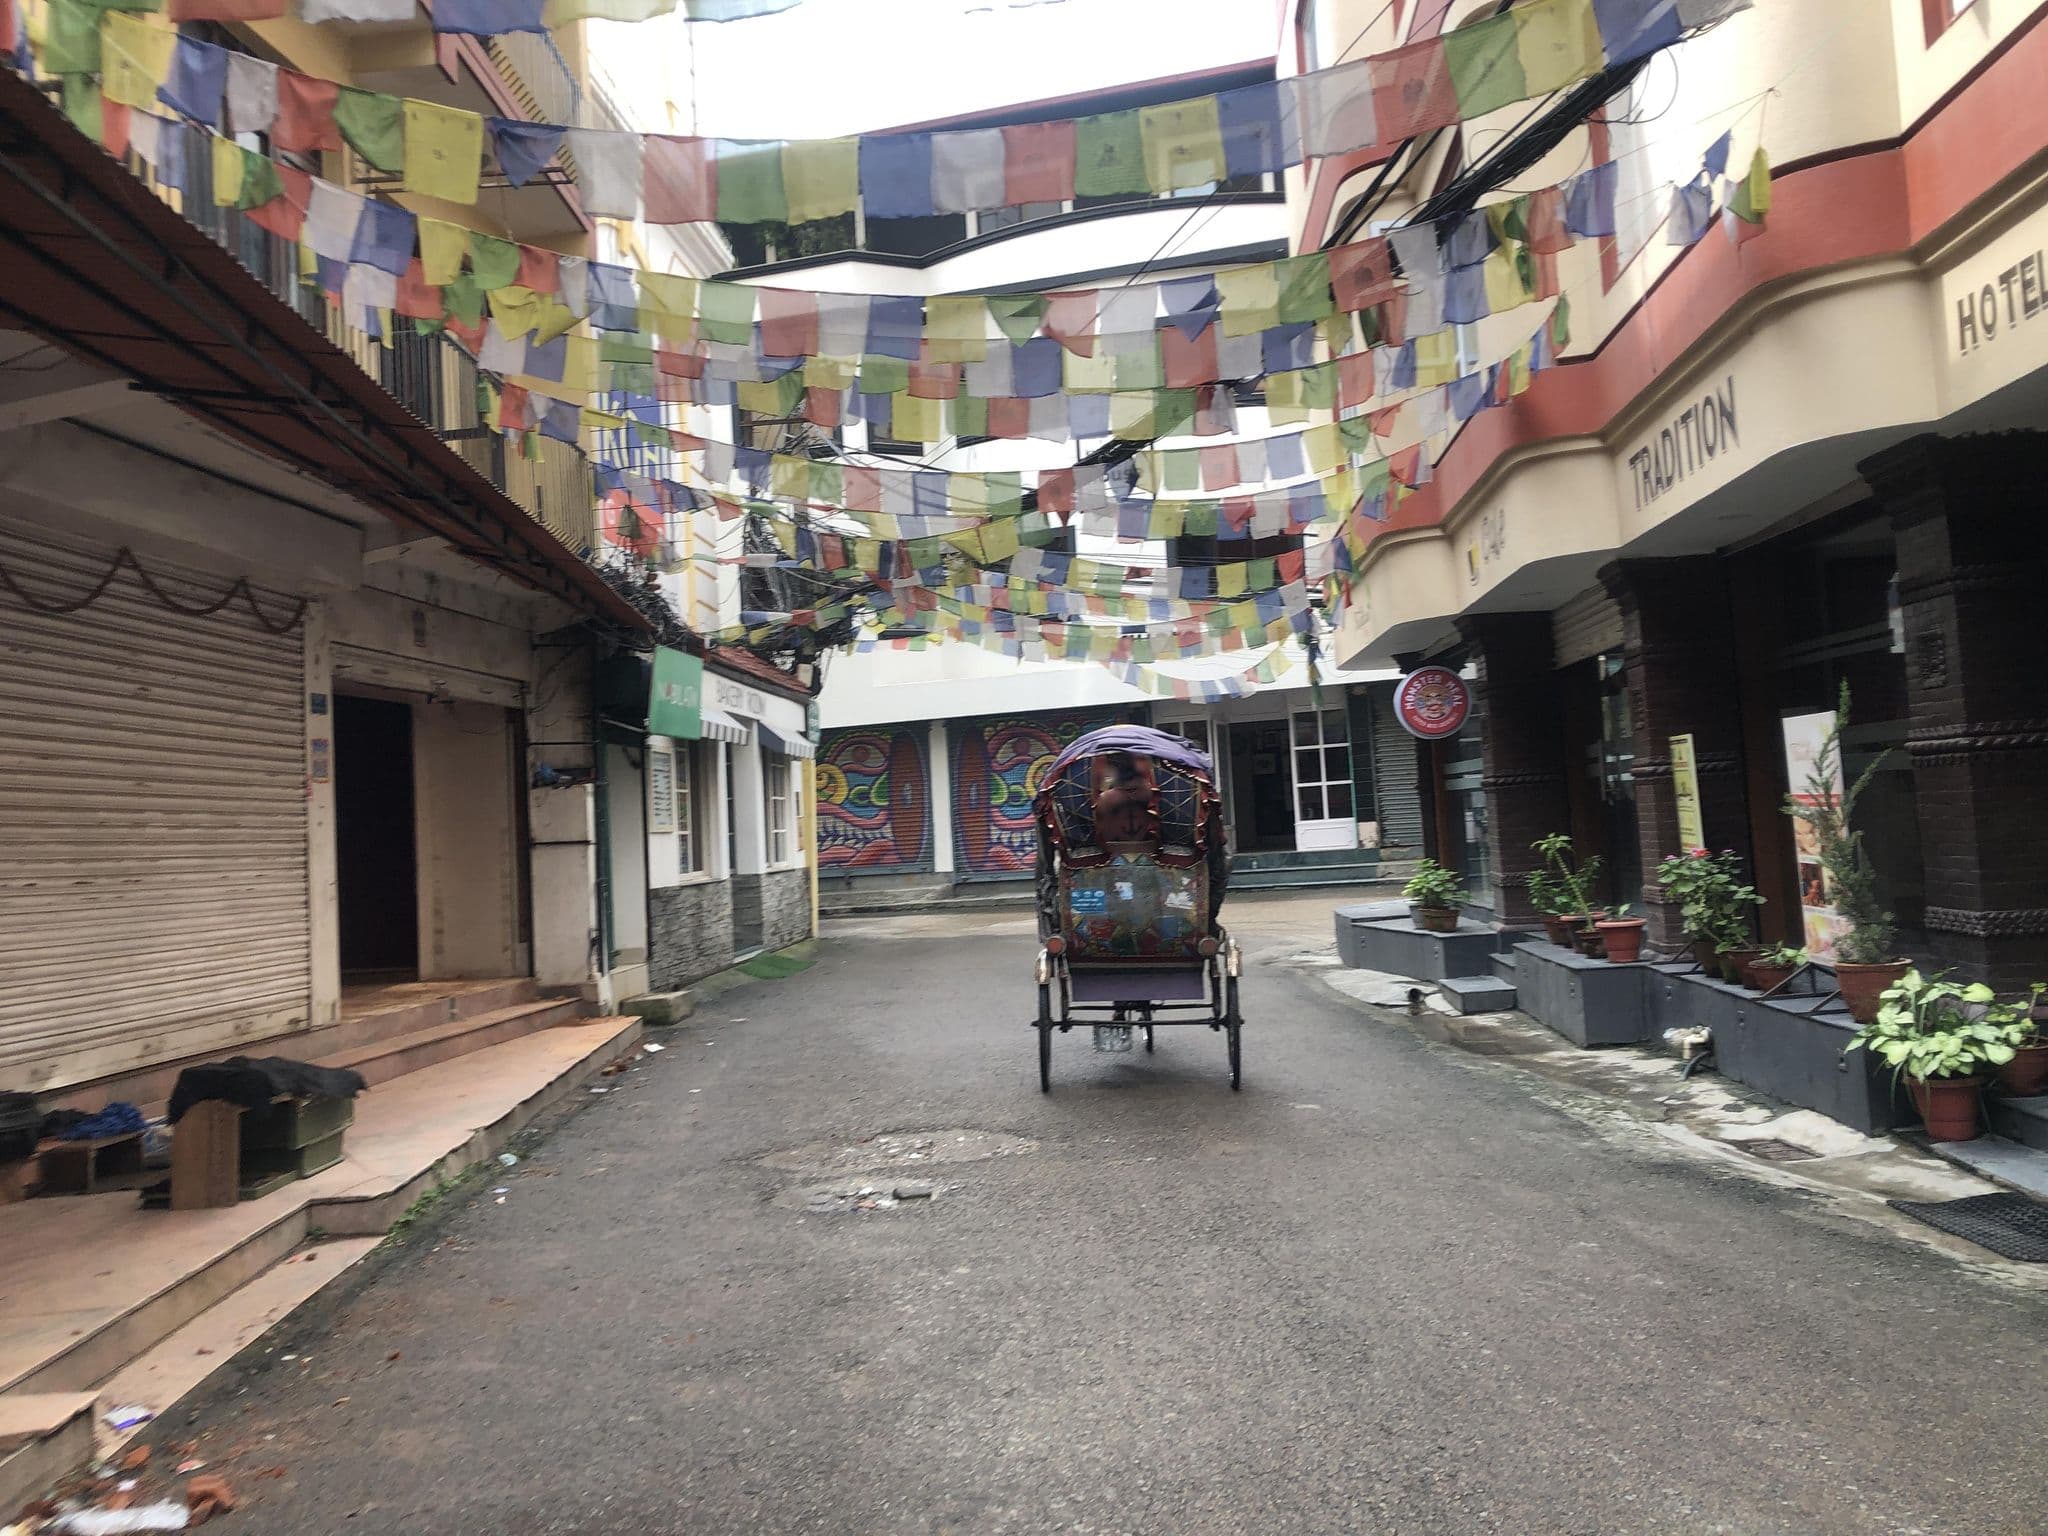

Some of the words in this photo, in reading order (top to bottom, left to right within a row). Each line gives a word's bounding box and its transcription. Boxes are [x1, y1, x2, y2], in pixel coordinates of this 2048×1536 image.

[1957, 249, 2048, 356] HOTEL
[1628, 375, 1741, 512] TRADITION
[1404, 674, 1442, 710] MONSTER
[1443, 681, 1464, 707] MEAL
